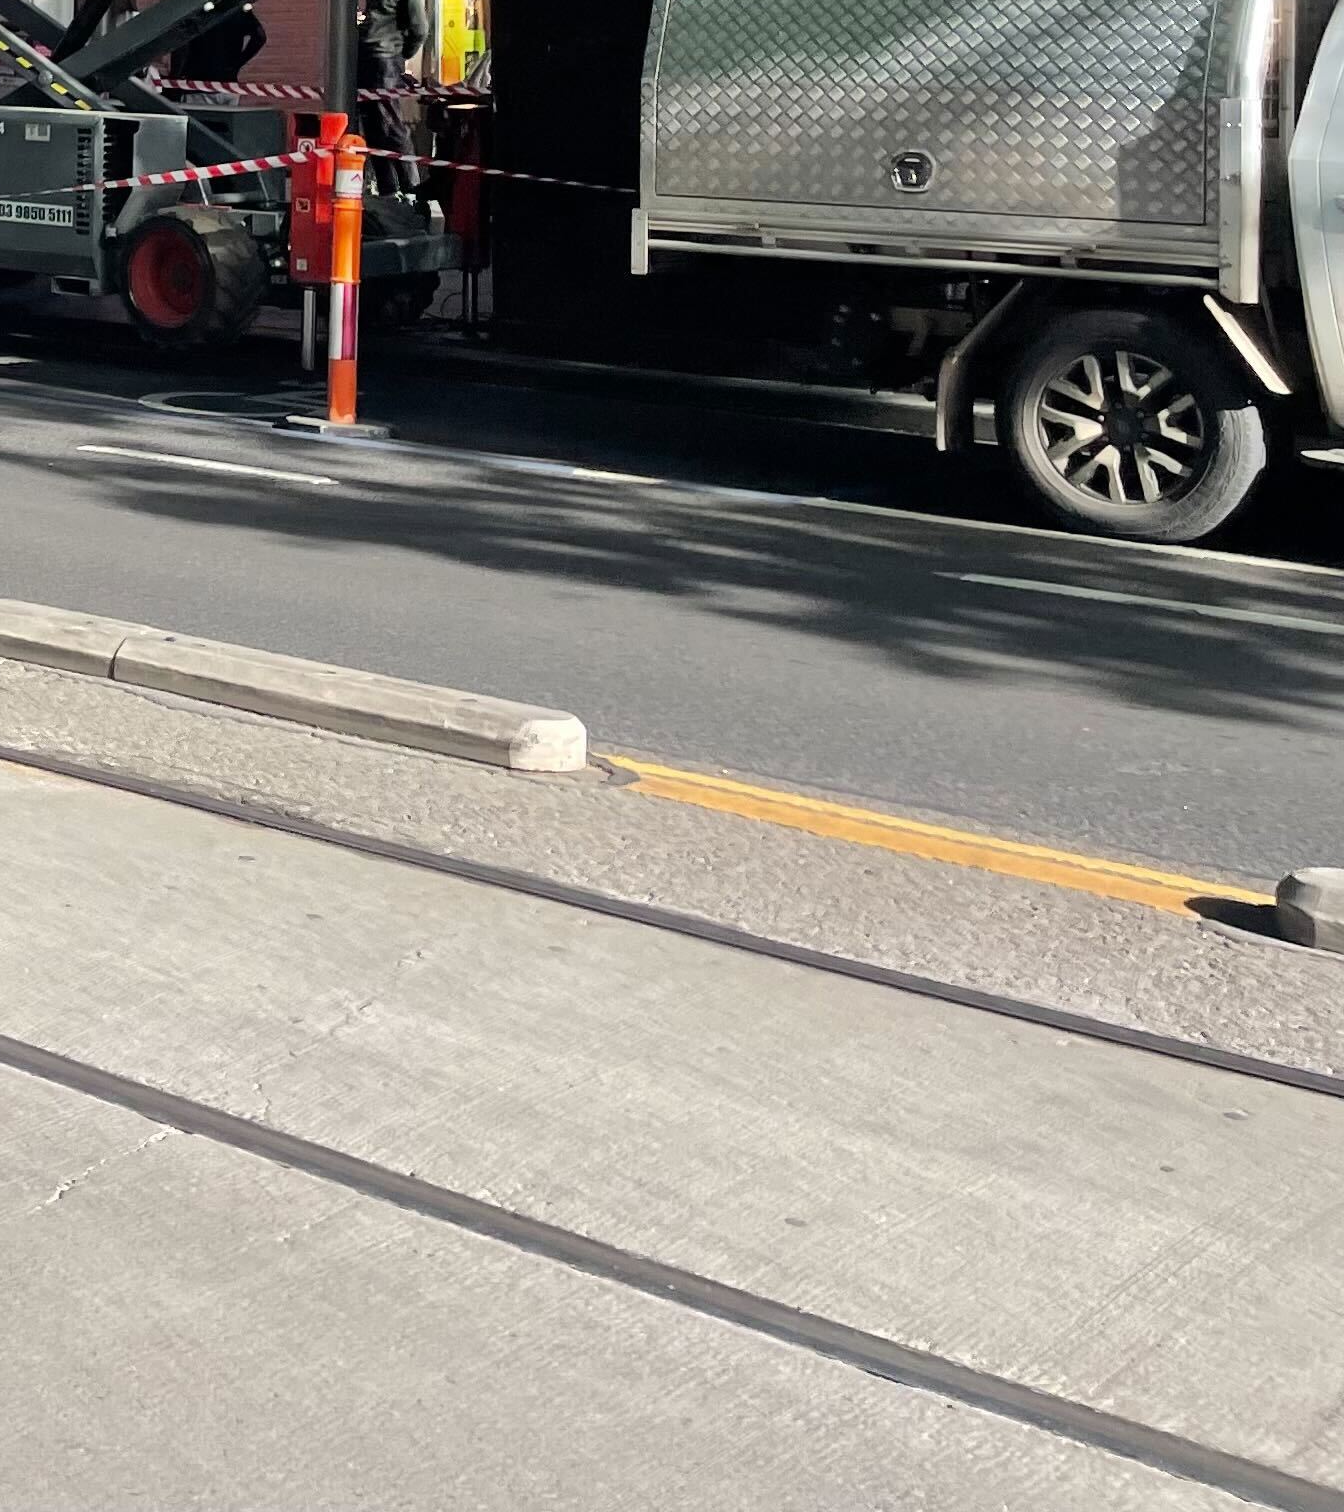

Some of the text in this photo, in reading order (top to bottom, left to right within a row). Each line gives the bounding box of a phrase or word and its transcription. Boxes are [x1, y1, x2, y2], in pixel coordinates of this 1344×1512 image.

[0, 203, 13, 218] 03
[15, 206, 45, 221] 9850
[48, 208, 73, 224] 5111
